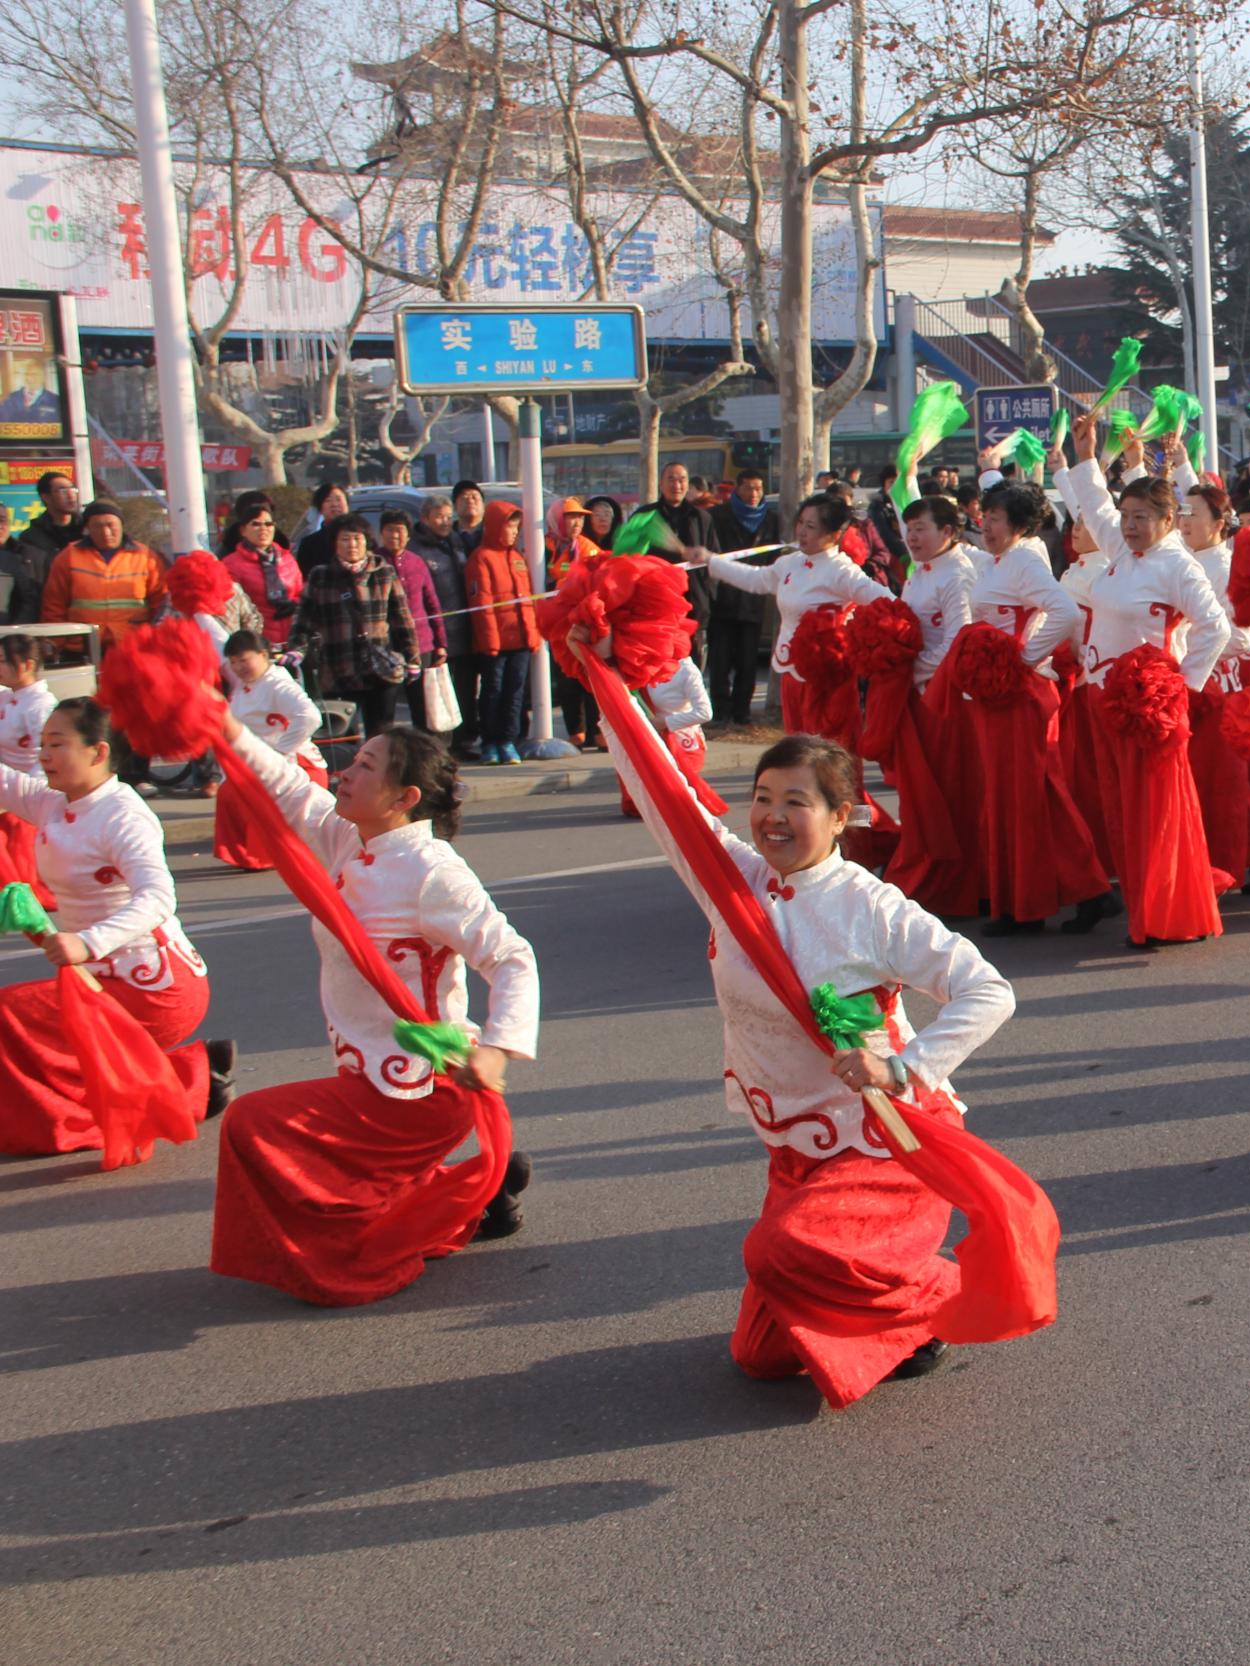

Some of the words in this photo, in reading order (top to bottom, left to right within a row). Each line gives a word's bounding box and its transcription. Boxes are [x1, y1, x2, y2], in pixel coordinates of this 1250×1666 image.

[440, 318, 601, 350] 实验路
[455, 361, 468, 375] 西
[495, 360, 535, 375] SHIYAN
[542, 360, 557, 374] LU
[582, 360, 593, 373] 东
[1012, 398, 1050, 419] 公共厕所
